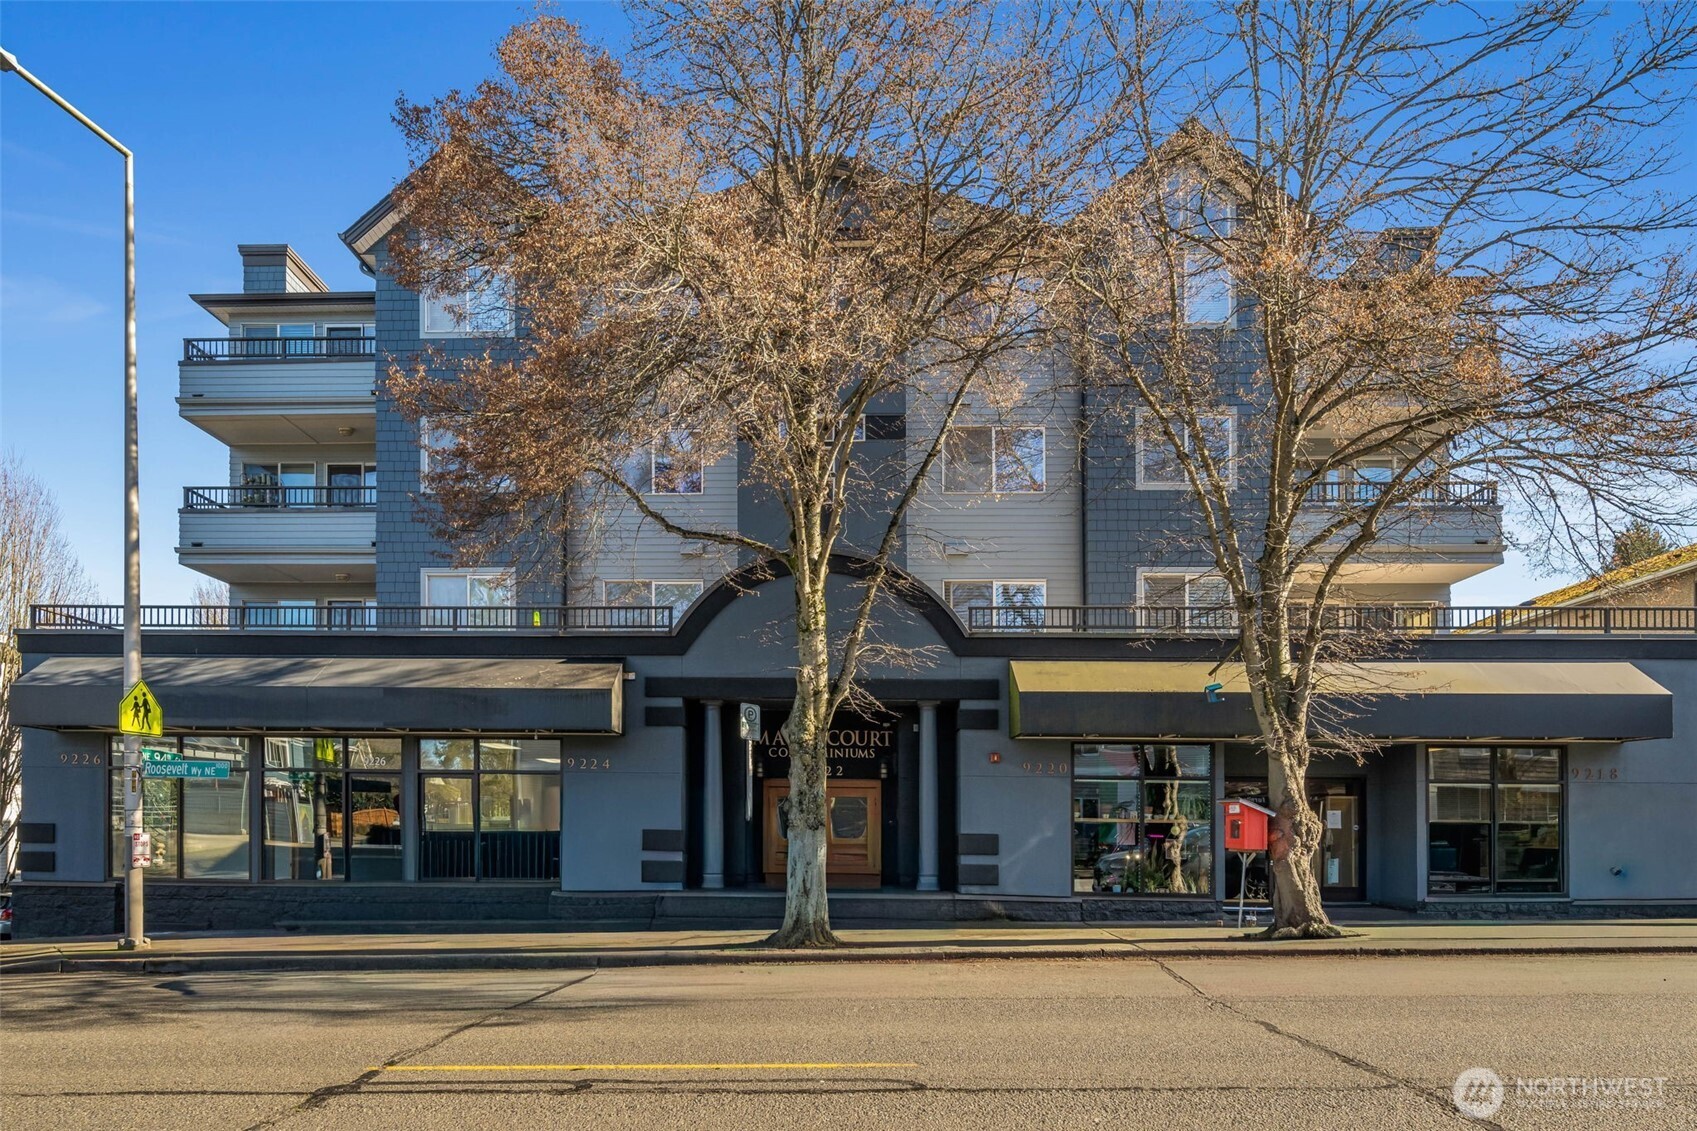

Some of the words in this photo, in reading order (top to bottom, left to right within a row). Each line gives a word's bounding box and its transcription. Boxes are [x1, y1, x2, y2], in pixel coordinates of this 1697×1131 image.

[827, 730, 893, 746] COURT
[60, 753, 101, 765] 9226
[768, 747, 875, 759] COINIUMS
[364, 756, 386, 766] 9226
[567, 757, 610, 769] 9224
[145, 761, 188, 775] Roosevelt
[191, 766, 202, 776] Wy
[204, 766, 216, 776] NE
[1022, 762, 1068, 774] 9220
[1571, 767, 1619, 781] 9218
